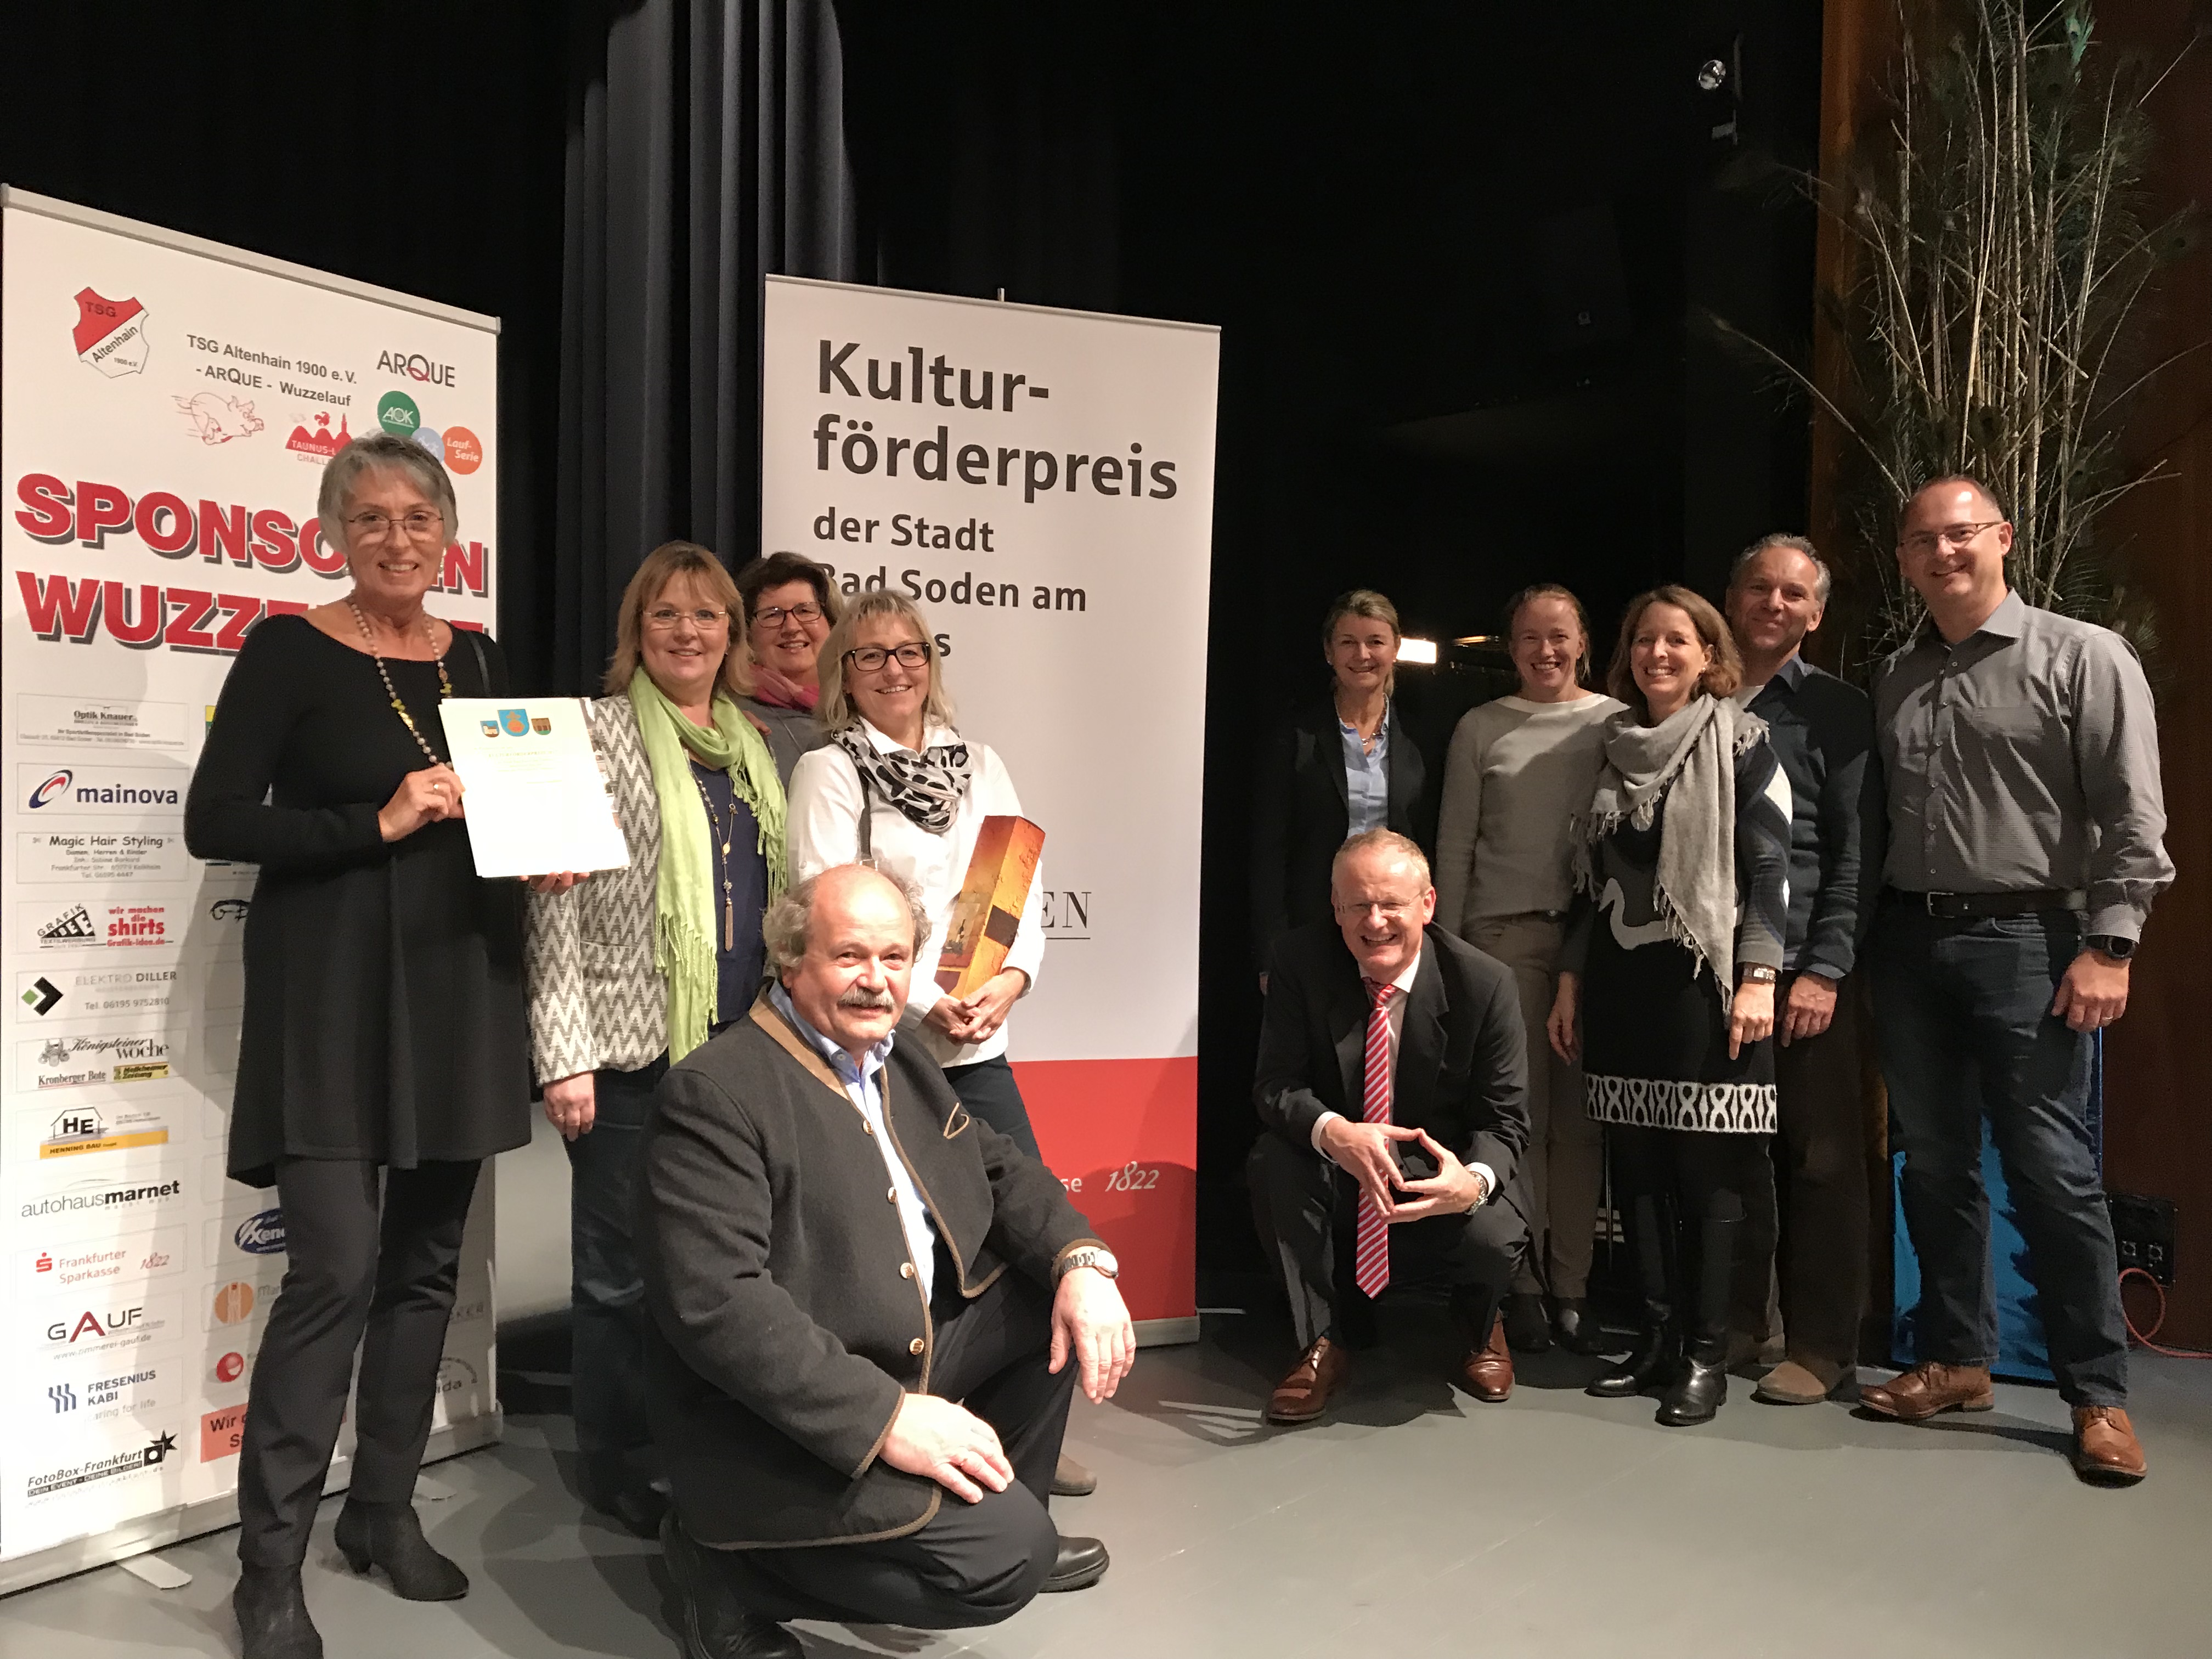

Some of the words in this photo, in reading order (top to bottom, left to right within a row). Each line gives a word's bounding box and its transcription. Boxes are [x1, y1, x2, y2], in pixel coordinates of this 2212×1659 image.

[86, 301, 117, 318] TSG
[92, 326, 138, 363] Altenhain
[187, 334, 219, 353] TSG
[223, 343, 291, 370] Altenhain
[296, 360, 328, 378] 1900
[376, 349, 455, 388] ARQUE
[819, 340, 1049, 413] Kultur-
[204, 365, 263, 389] ARQUE
[279, 381, 352, 407] Wuzzelauf
[382, 407, 414, 425] AOK
[447, 437, 472, 450] Lauf-
[454, 449, 479, 462] Serie
[813, 413, 1178, 504] förderpreis
[15, 473, 488, 598] SPONSON
[814, 506, 879, 544] der
[890, 514, 995, 552] Stadt
[901, 569, 1019, 608] Soden
[1032, 584, 1086, 612] am
[74, 710, 98, 719] Optik
[100, 712, 133, 720] Knauer
[76, 783, 178, 805] mainova
[49, 836, 85, 849] Magic
[90, 836, 117, 846] Hair
[122, 836, 163, 849] Styling
[108, 906, 125, 915] wir
[128, 905, 165, 913] machen
[37, 903, 84, 937] GRAFIK
[108, 918, 165, 936] shirts
[75, 973, 132, 986] ELEKTRO
[136, 970, 177, 983] DILLER
[103, 1000, 131, 1009] 06195
[133, 997, 170, 1007] 9752810
[68, 1037, 147, 1054] Königsteiner
[38, 1073, 86, 1086] Kronberger
[88, 1070, 106, 1081] Bote
[63, 1117, 94, 1135] HE
[49, 1144, 84, 1154] HENNING
[1104, 1160, 1160, 1192] 1822
[59, 1250, 127, 1268] Frankfurter
[140, 1251, 170, 1270] 1822
[59, 1266, 121, 1285] Sparkasse
[47, 1307, 143, 1344] GAUF
[87, 1369, 156, 1393] FRESENIUS
[87, 1391, 119, 1407] KABI
[122, 1404, 137, 1413] for
[139, 1398, 156, 1409] life
[210, 1415, 236, 1433] Wir
[28, 1449, 143, 1488] FotoBox-Frankfurt
